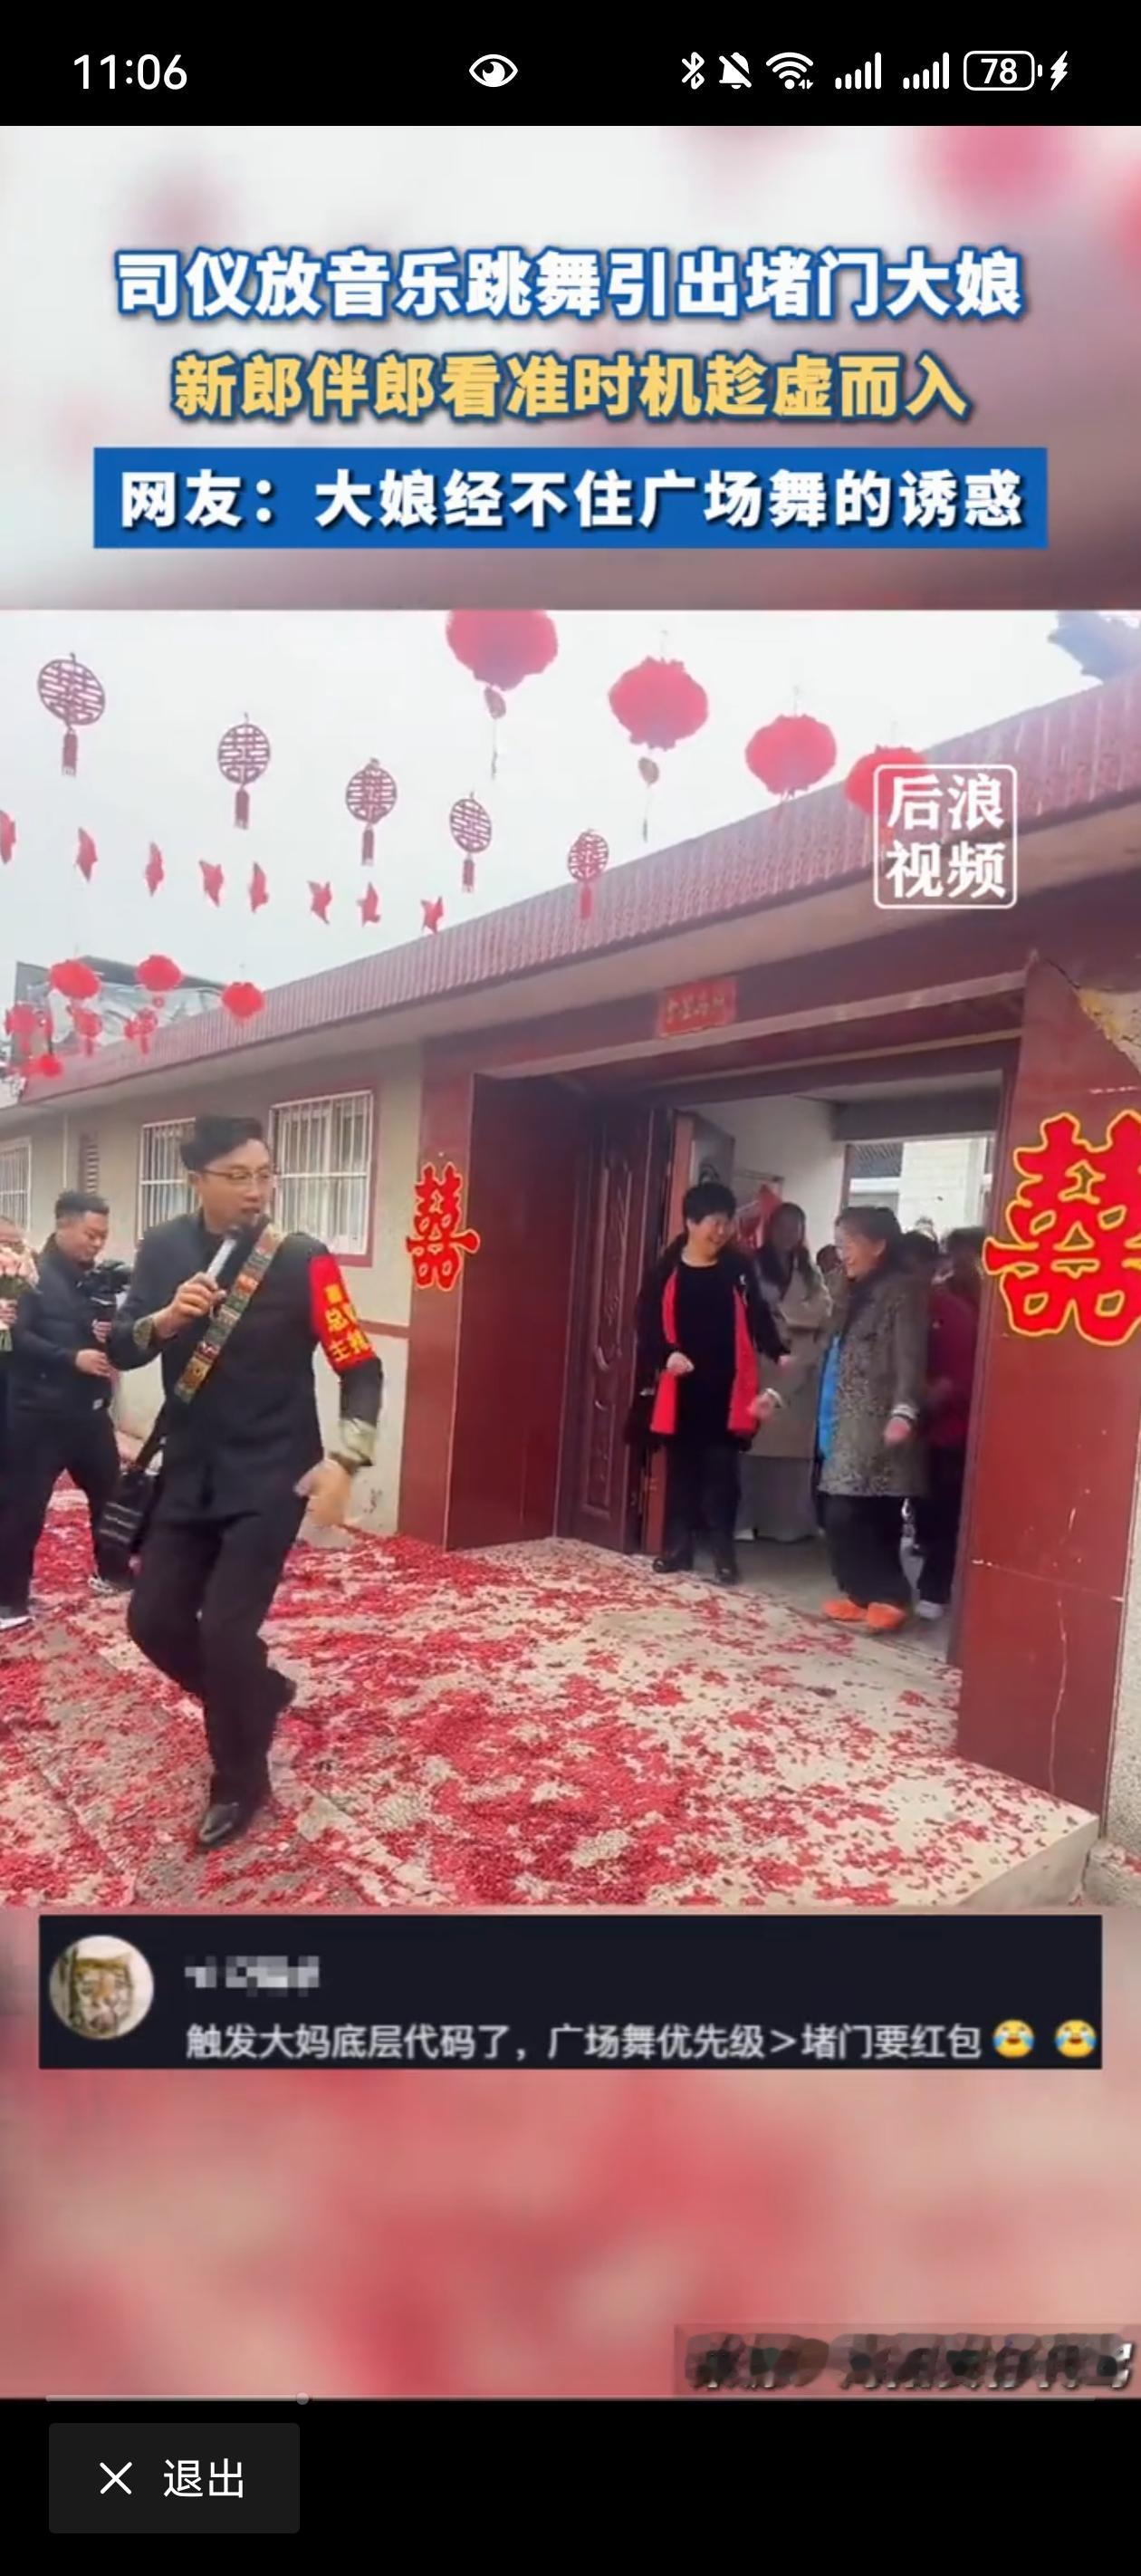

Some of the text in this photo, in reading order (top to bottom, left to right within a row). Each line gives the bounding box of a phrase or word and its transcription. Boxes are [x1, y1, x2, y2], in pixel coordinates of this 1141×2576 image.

[73, 54, 187, 91] 11:06
[981, 58, 1018, 84] 78
[163, 2457, 244, 2498] 退出
